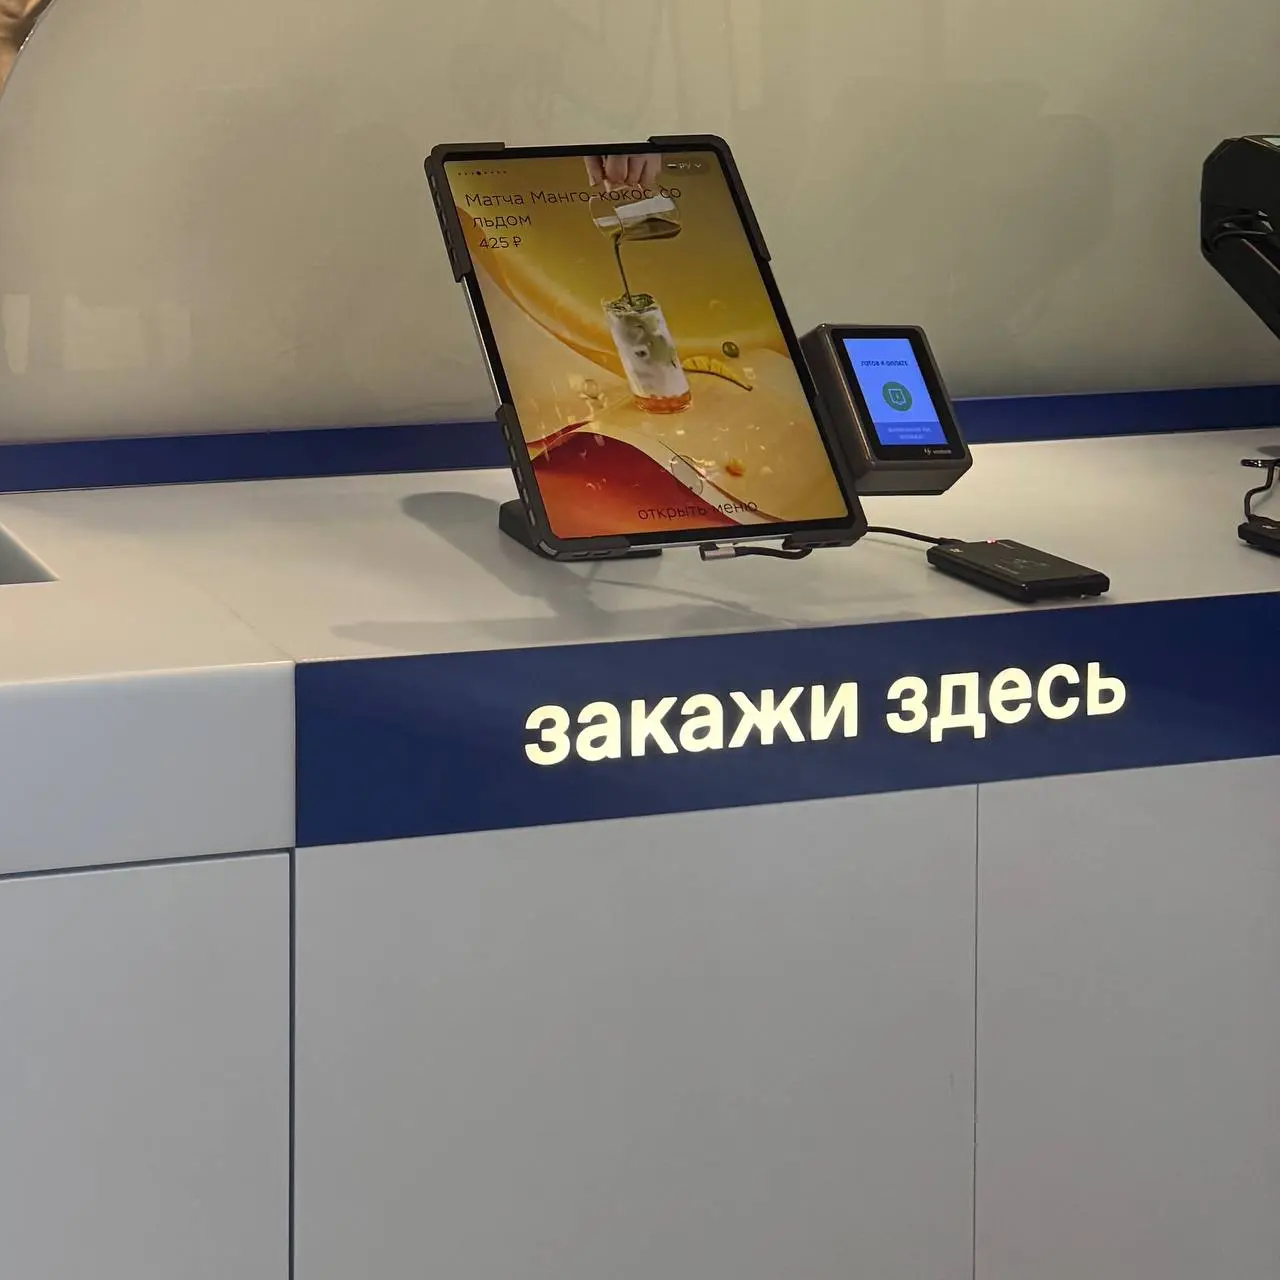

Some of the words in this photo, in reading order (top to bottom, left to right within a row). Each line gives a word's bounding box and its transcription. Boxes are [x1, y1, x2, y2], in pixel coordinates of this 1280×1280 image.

[465, 192, 524, 208] Матча
[530, 188, 654, 205] Манго-кокос
[660, 187, 681, 199] со
[473, 214, 532, 228] льдом
[479, 237, 509, 249] 425
[638, 505, 707, 521] открыть
[524, 681, 858, 766] закажи
[886, 661, 1127, 742] здесь
